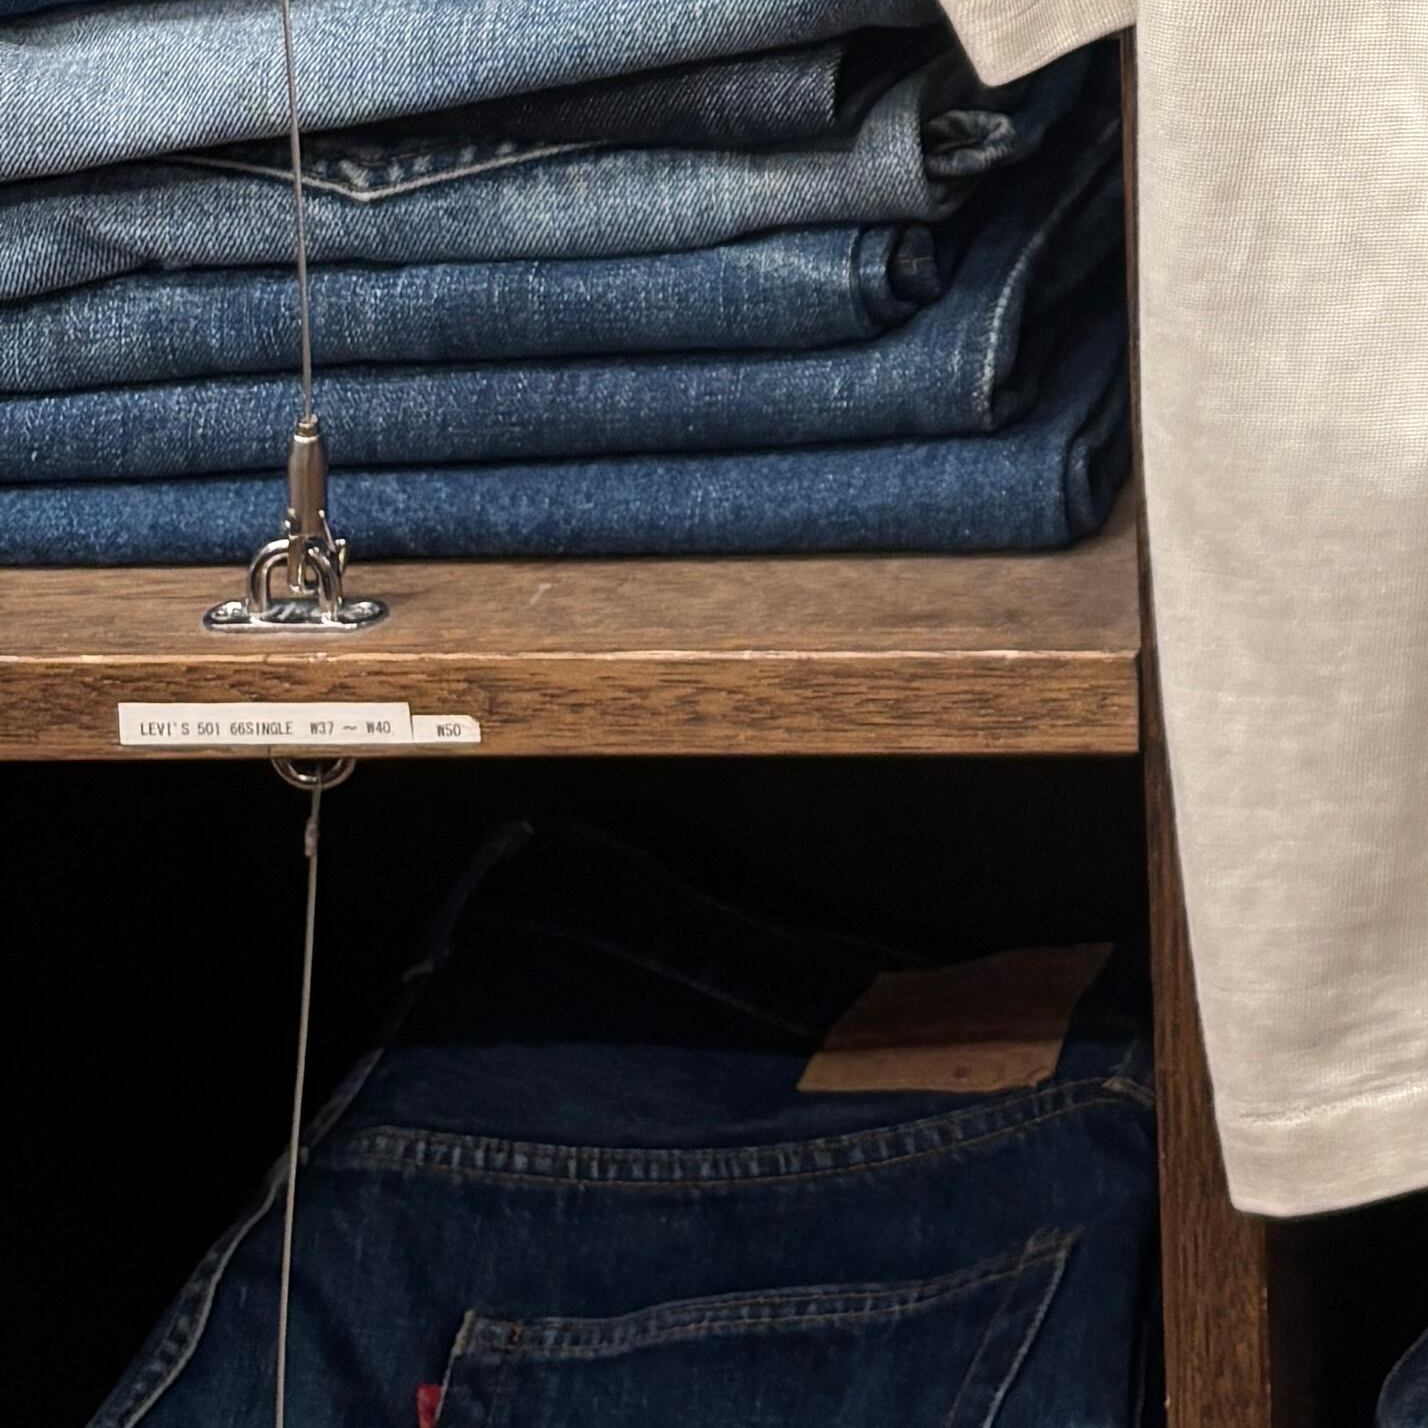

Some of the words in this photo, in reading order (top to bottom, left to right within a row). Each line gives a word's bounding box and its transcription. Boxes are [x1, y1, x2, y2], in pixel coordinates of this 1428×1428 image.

[140, 721, 191, 737] LEVI'S
[197, 721, 220, 737] 501
[229, 720, 294, 737] 66SINGLE
[309, 720, 335, 735] W37
[365, 720, 392, 734] W40
[436, 722, 462, 738] W50
